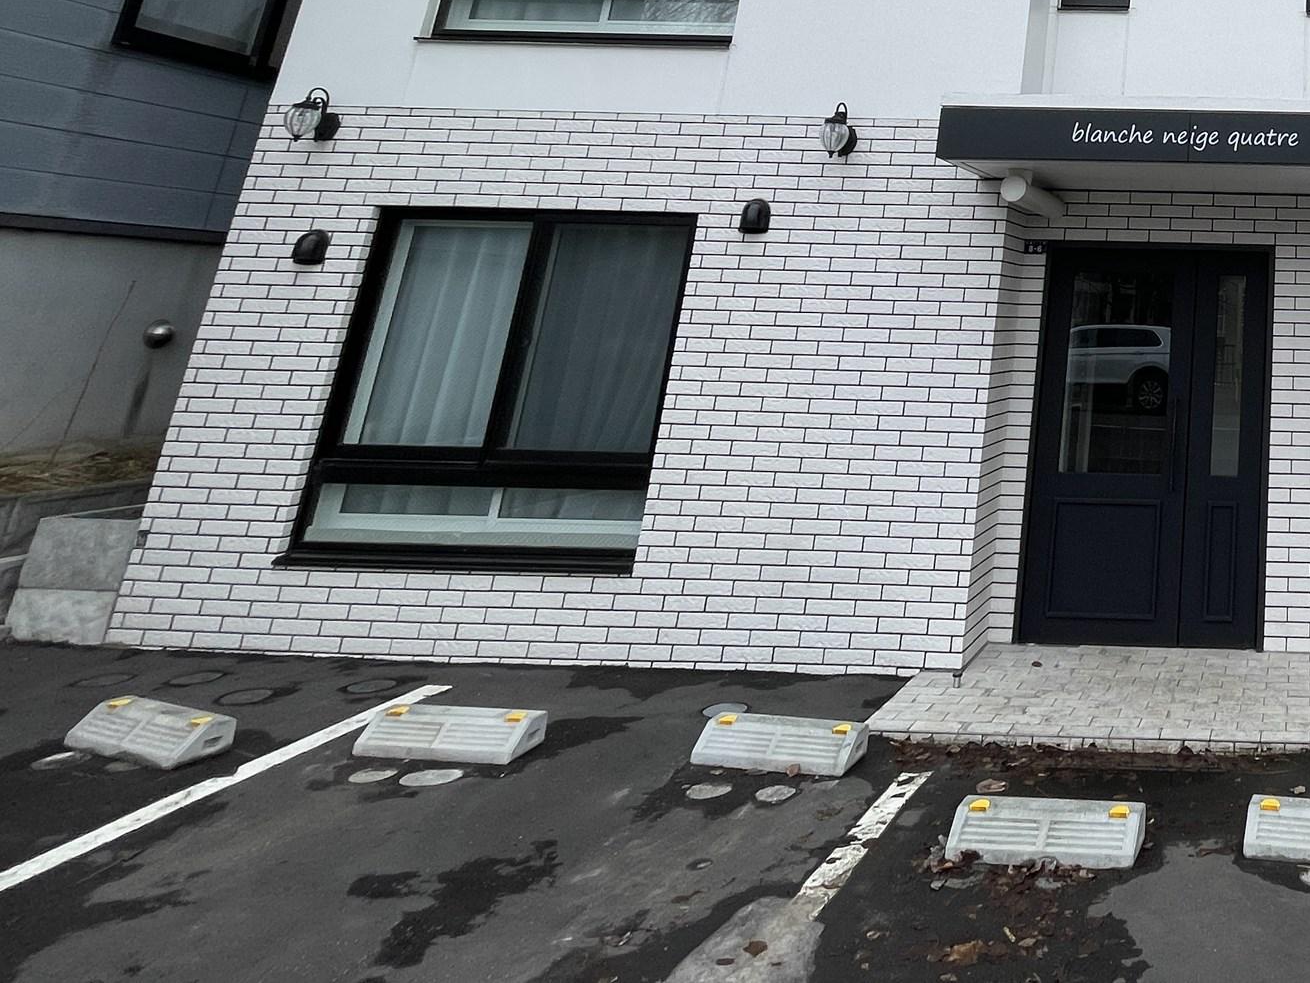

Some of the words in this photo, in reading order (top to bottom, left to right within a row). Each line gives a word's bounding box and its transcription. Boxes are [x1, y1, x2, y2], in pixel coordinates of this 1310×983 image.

[1071, 121, 1154, 144] blanche
[1162, 125, 1219, 151] neige
[1227, 128, 1299, 151] quatre
